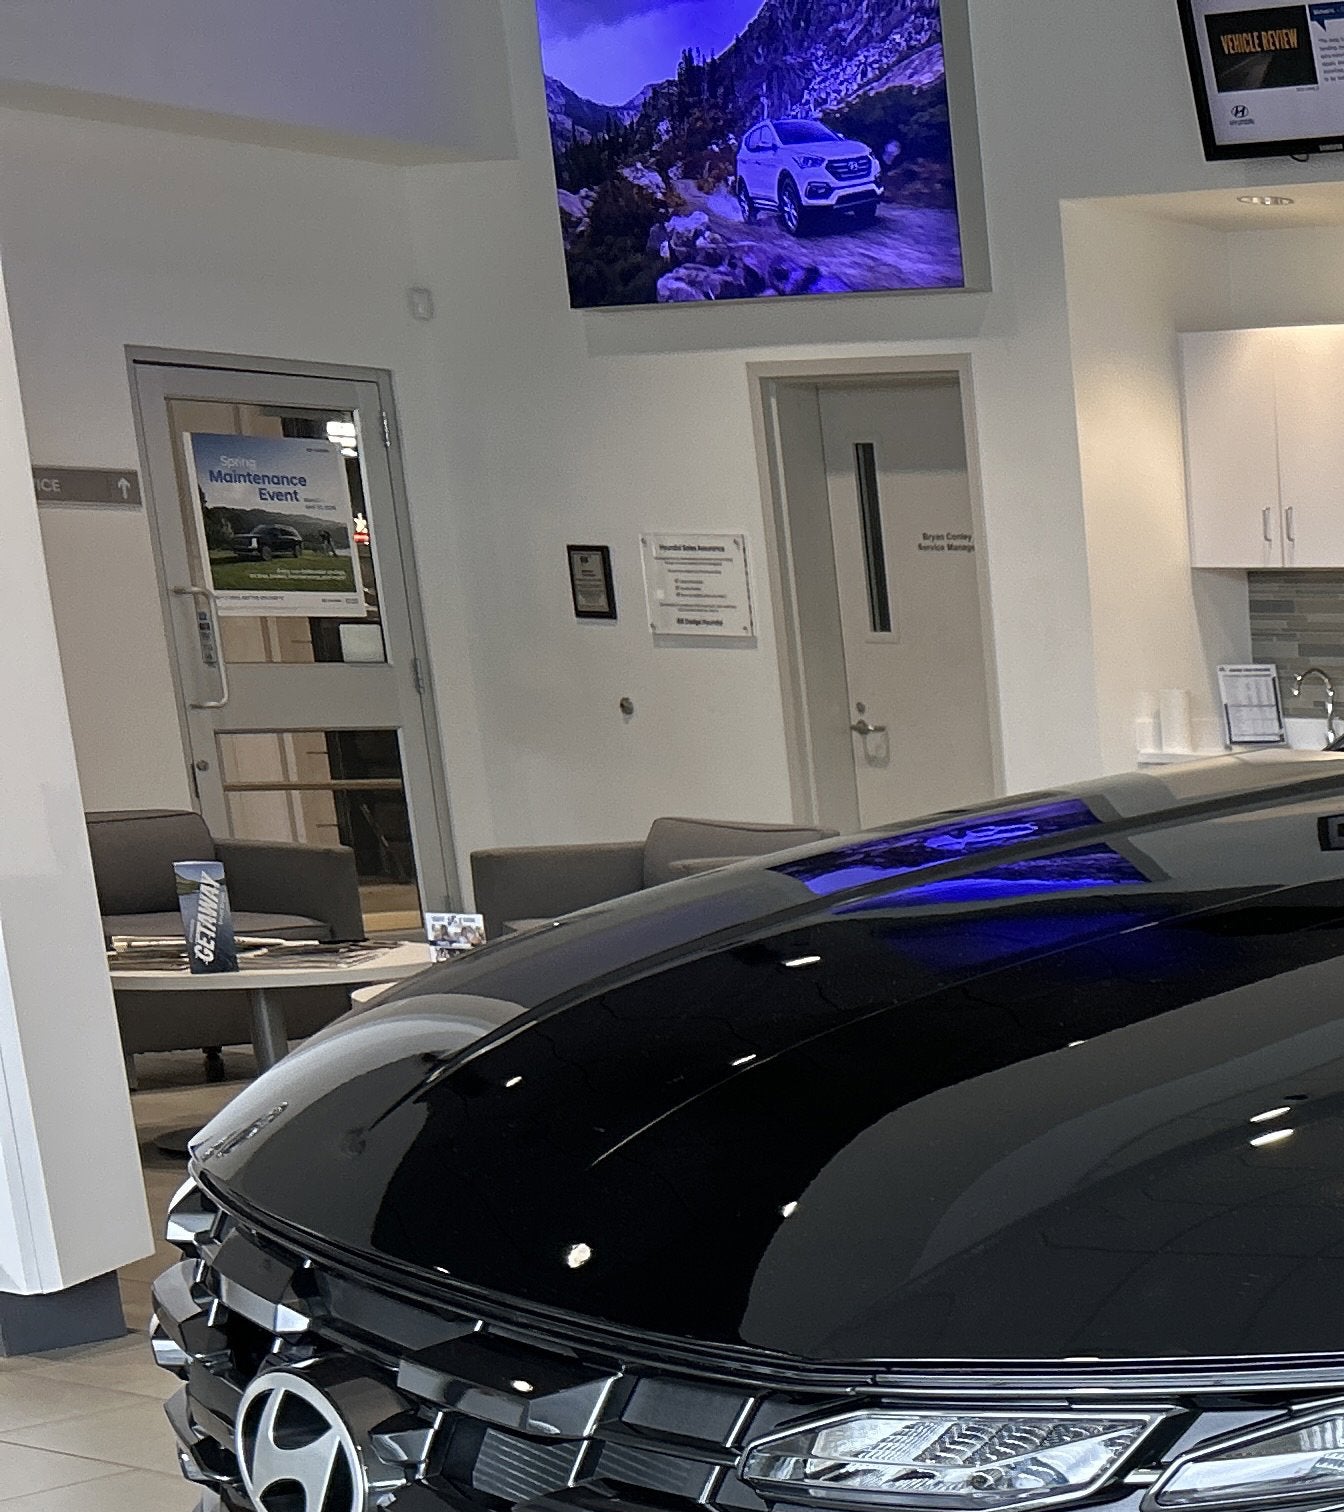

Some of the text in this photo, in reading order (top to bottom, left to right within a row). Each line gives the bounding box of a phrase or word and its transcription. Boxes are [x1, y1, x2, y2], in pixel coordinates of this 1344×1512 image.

[1220, 28, 1298, 55] VEHICLE REVIEW
[219, 455, 257, 468] Spring
[34, 478, 61, 493] ICE
[208, 469, 307, 487] Maintenance
[258, 487, 300, 502] Event
[192, 869, 220, 966] GETAWAY
